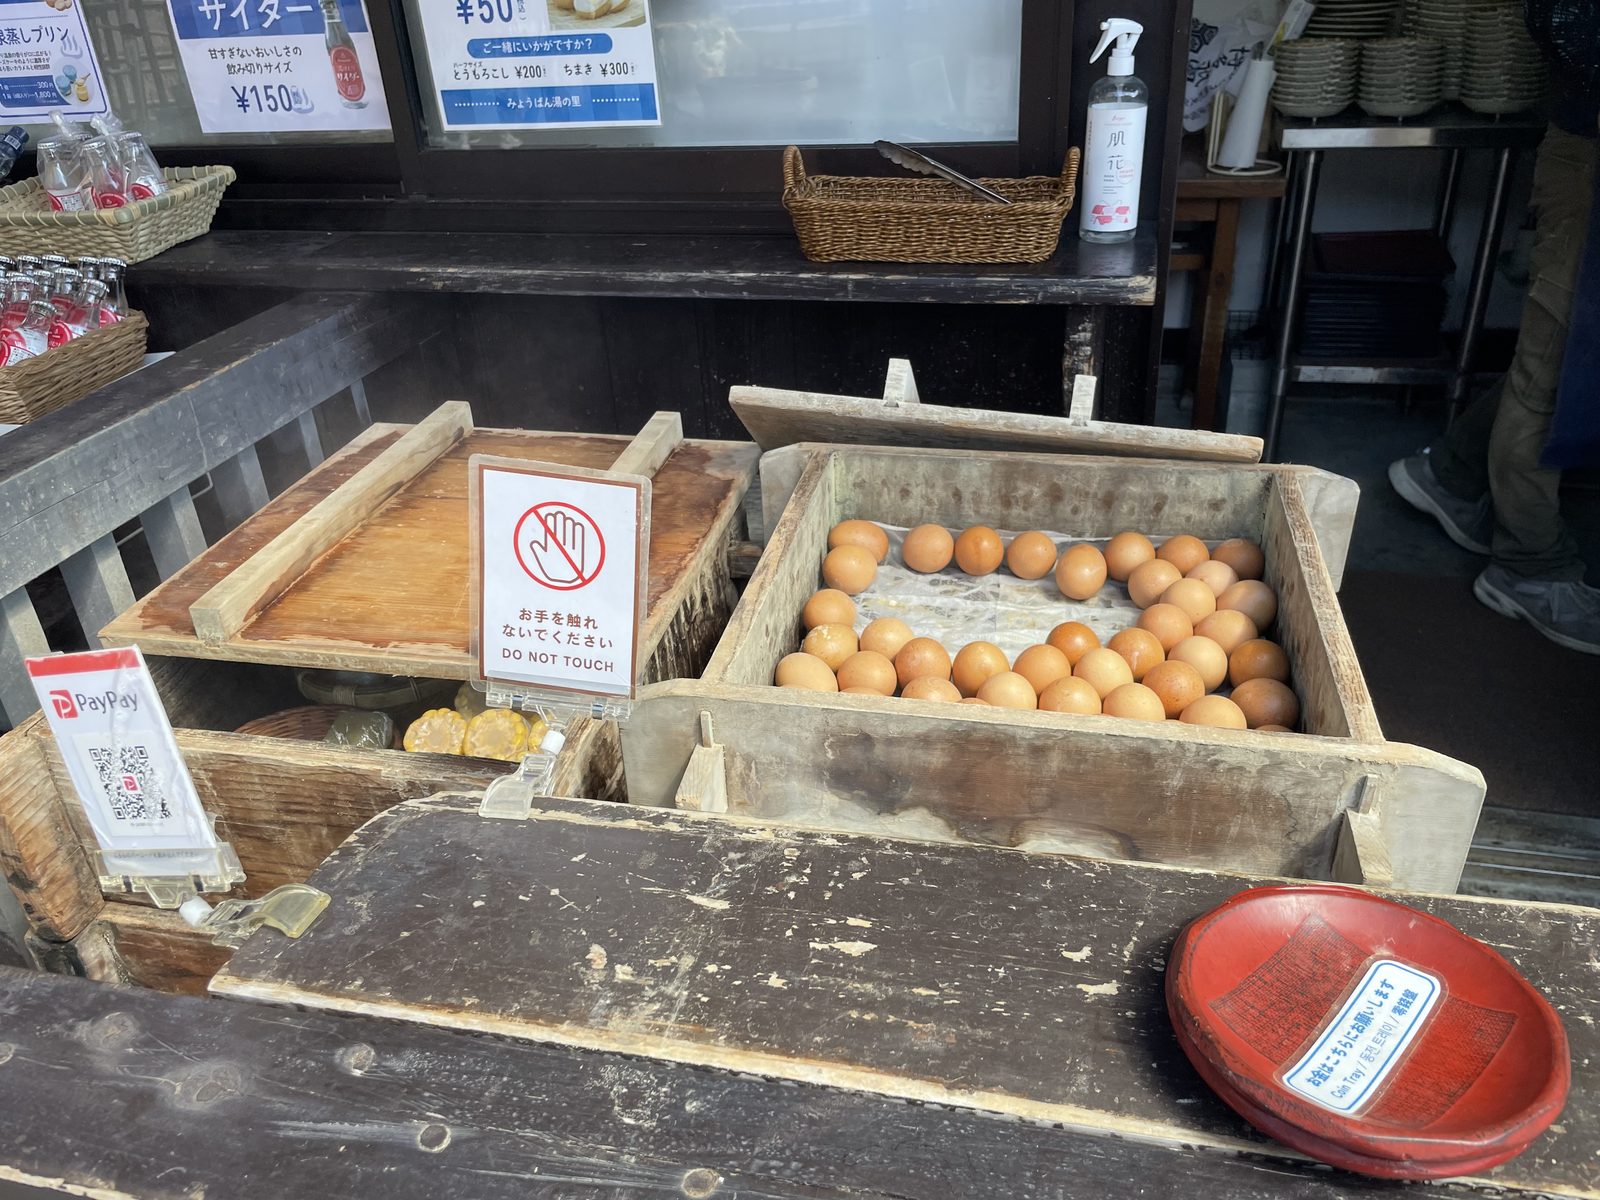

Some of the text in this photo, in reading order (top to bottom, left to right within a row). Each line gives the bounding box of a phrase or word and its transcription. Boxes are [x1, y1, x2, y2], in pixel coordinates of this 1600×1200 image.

[198, 0, 313, 30] サイダー
[208, 46, 302, 60] 甘すぎないおいしさの
[483, 38, 592, 54] ご一緒にいかがですか？
[226, 62, 293, 75] 飲み切りサイズ
[454, 67, 509, 81] とうもろこし
[515, 65, 542, 79] ¥200
[563, 63, 592, 76] ちまき
[599, 62, 628, 77] ¥300
[231, 84, 292, 113] ¥150
[506, 96, 582, 108] みょうばん湯の里
[518, 608, 599, 630] お手を触れ
[502, 624, 613, 649] ないでください
[502, 647, 614, 673] DO NOT TOUCH
[75, 691, 138, 714] PayPay
[1305, 979, 1395, 1088] お金はこちらにお願いします
[1331, 1084, 1351, 1098] Coin
[1343, 1067, 1365, 1084] Tray
[1360, 1044, 1380, 1062] 동전
[1371, 1022, 1397, 1047] 트레이
